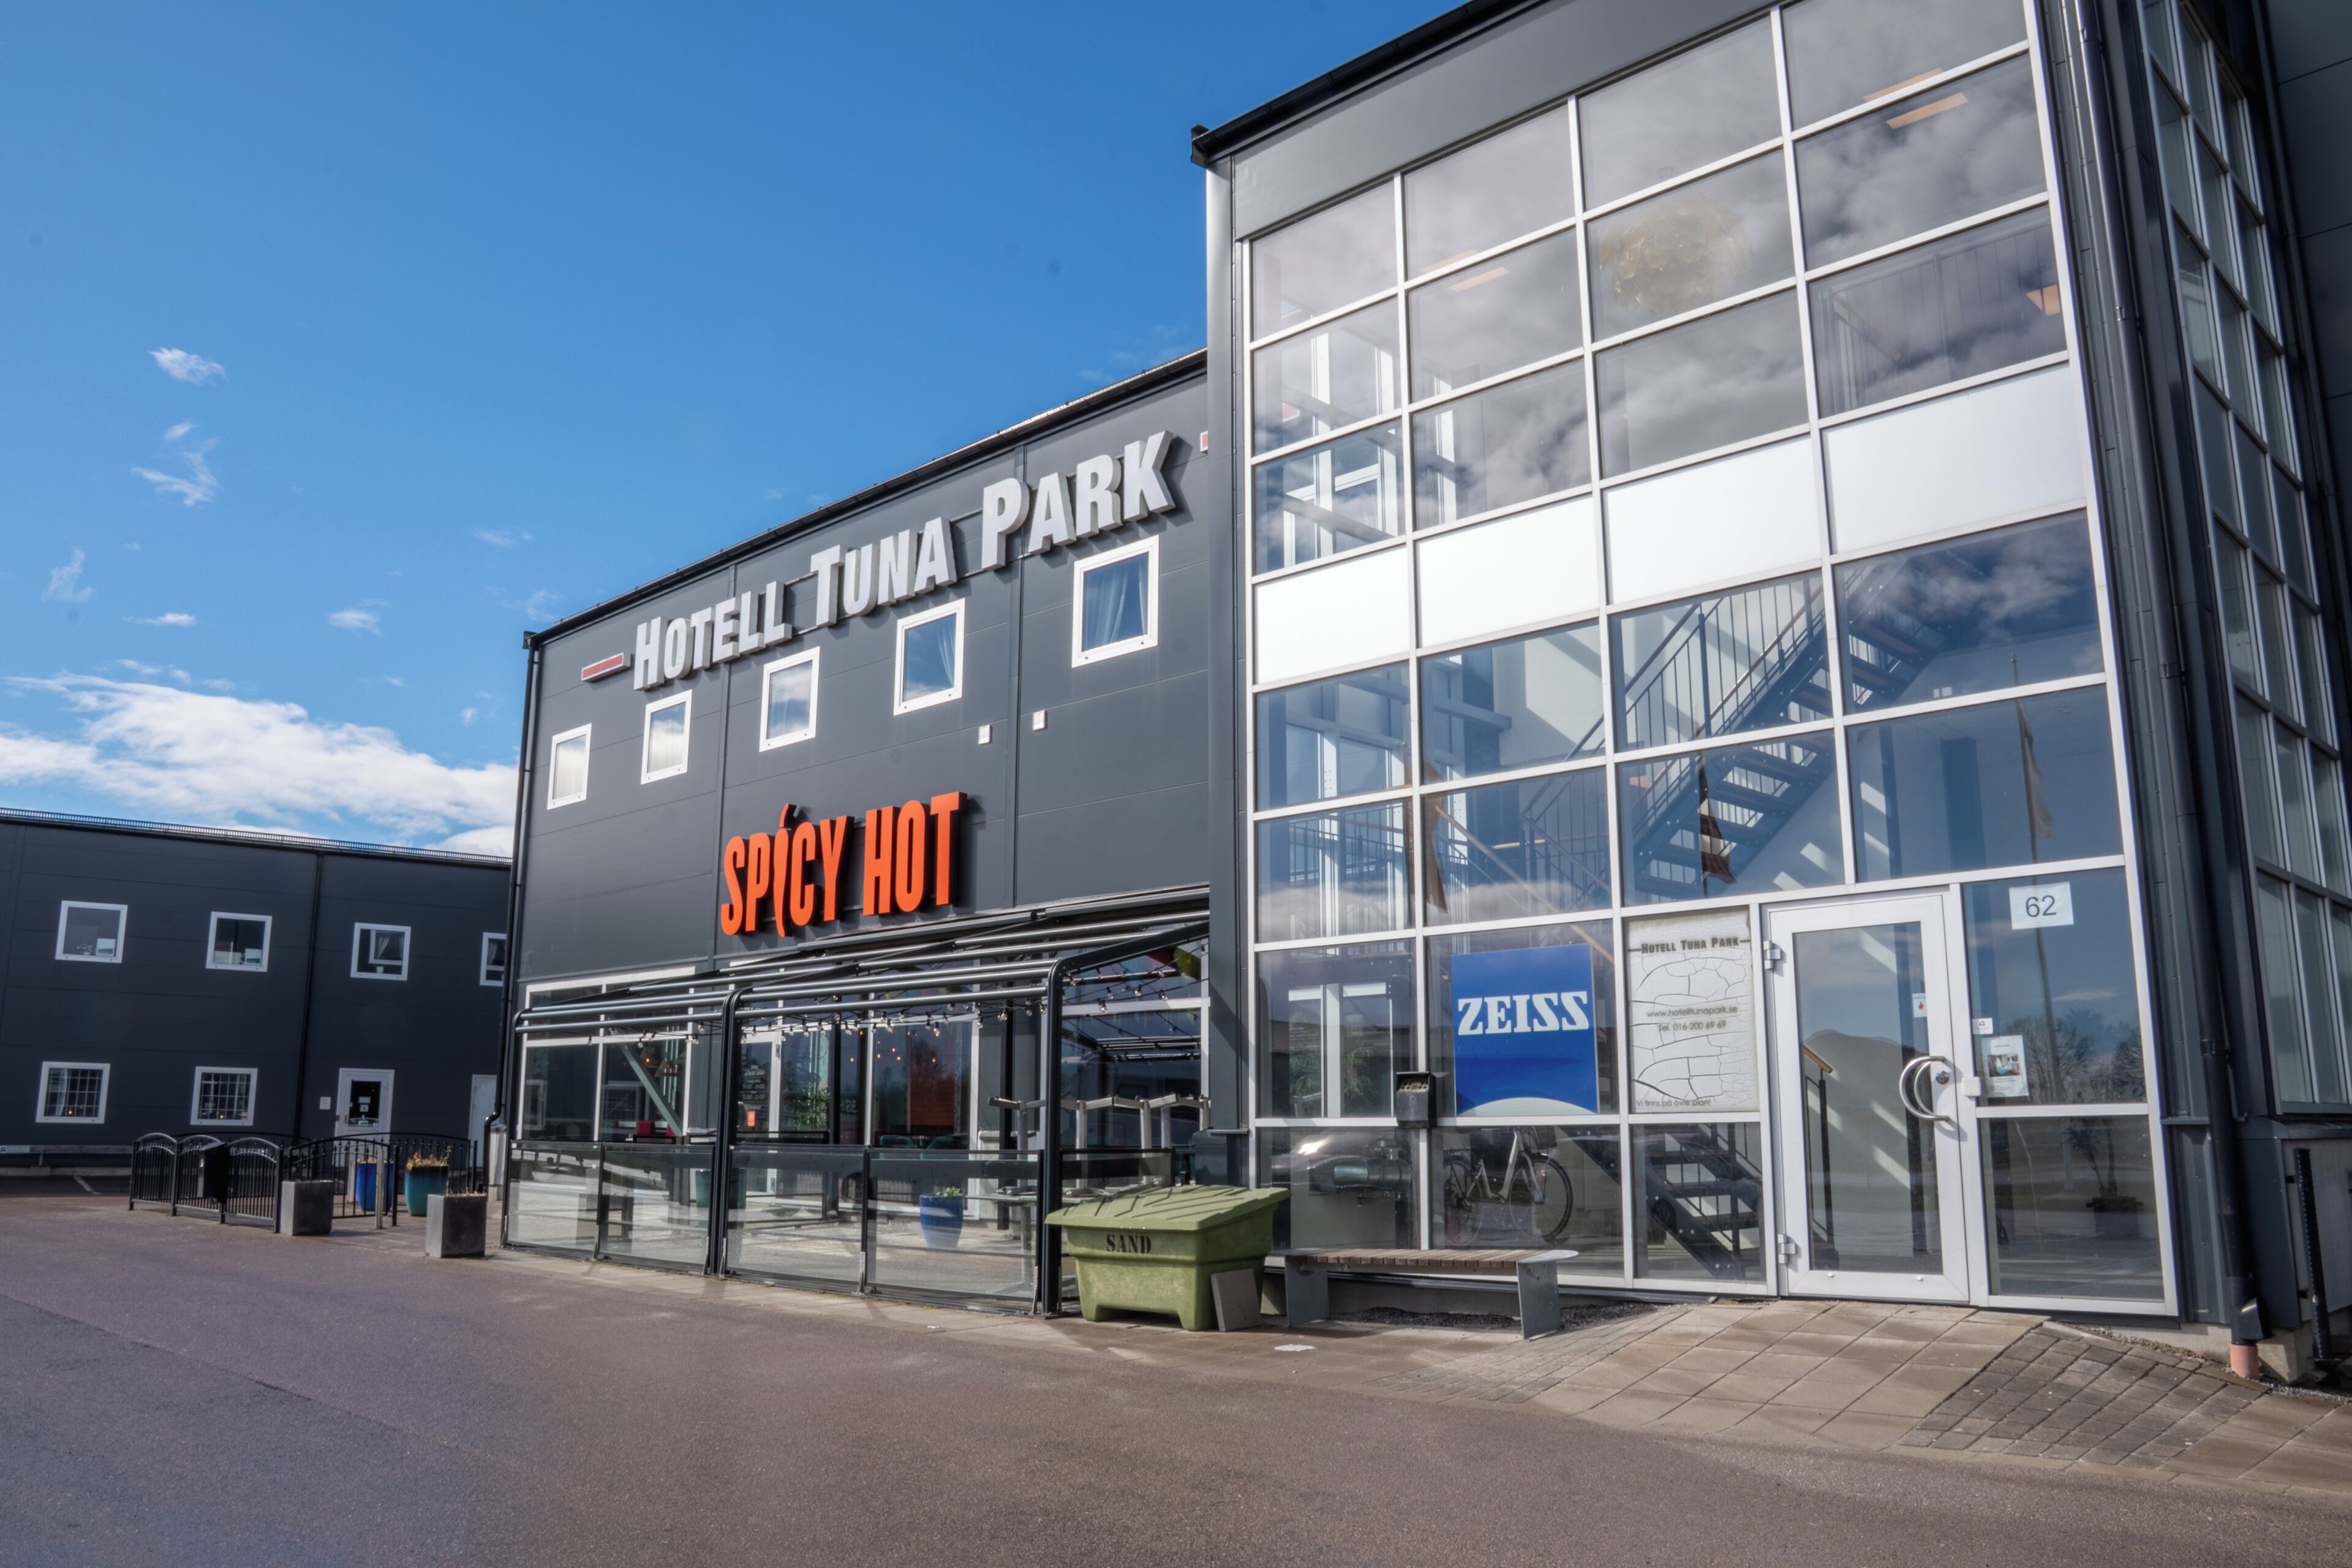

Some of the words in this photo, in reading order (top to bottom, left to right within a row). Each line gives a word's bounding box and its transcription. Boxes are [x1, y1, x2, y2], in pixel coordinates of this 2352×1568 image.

[633, 581, 792, 691] HOTELL
[810, 516, 957, 628] TUNA
[981, 430, 1175, 571] PARK
[721, 803, 851, 938] SPICY
[863, 791, 964, 916] HOT
[2026, 895, 2057, 918] 62
[1642, 943, 1676, 954] HOTELL
[1681, 940, 1707, 951] TUNA
[1711, 937, 1740, 948] PARK
[1458, 990, 1589, 1036] ZEISS
[1646, 1006, 1738, 1017] www.hotelltunapark.se
[1673, 1022, 1703, 1031] 016-200
[1705, 1021, 1715, 1030] 69
[1717, 1020, 1727, 1029] 69
[1662, 1099, 1672, 1107] på
[1692, 1099, 1711, 1107] plan!
[1106, 1234, 1152, 1254] SAND
